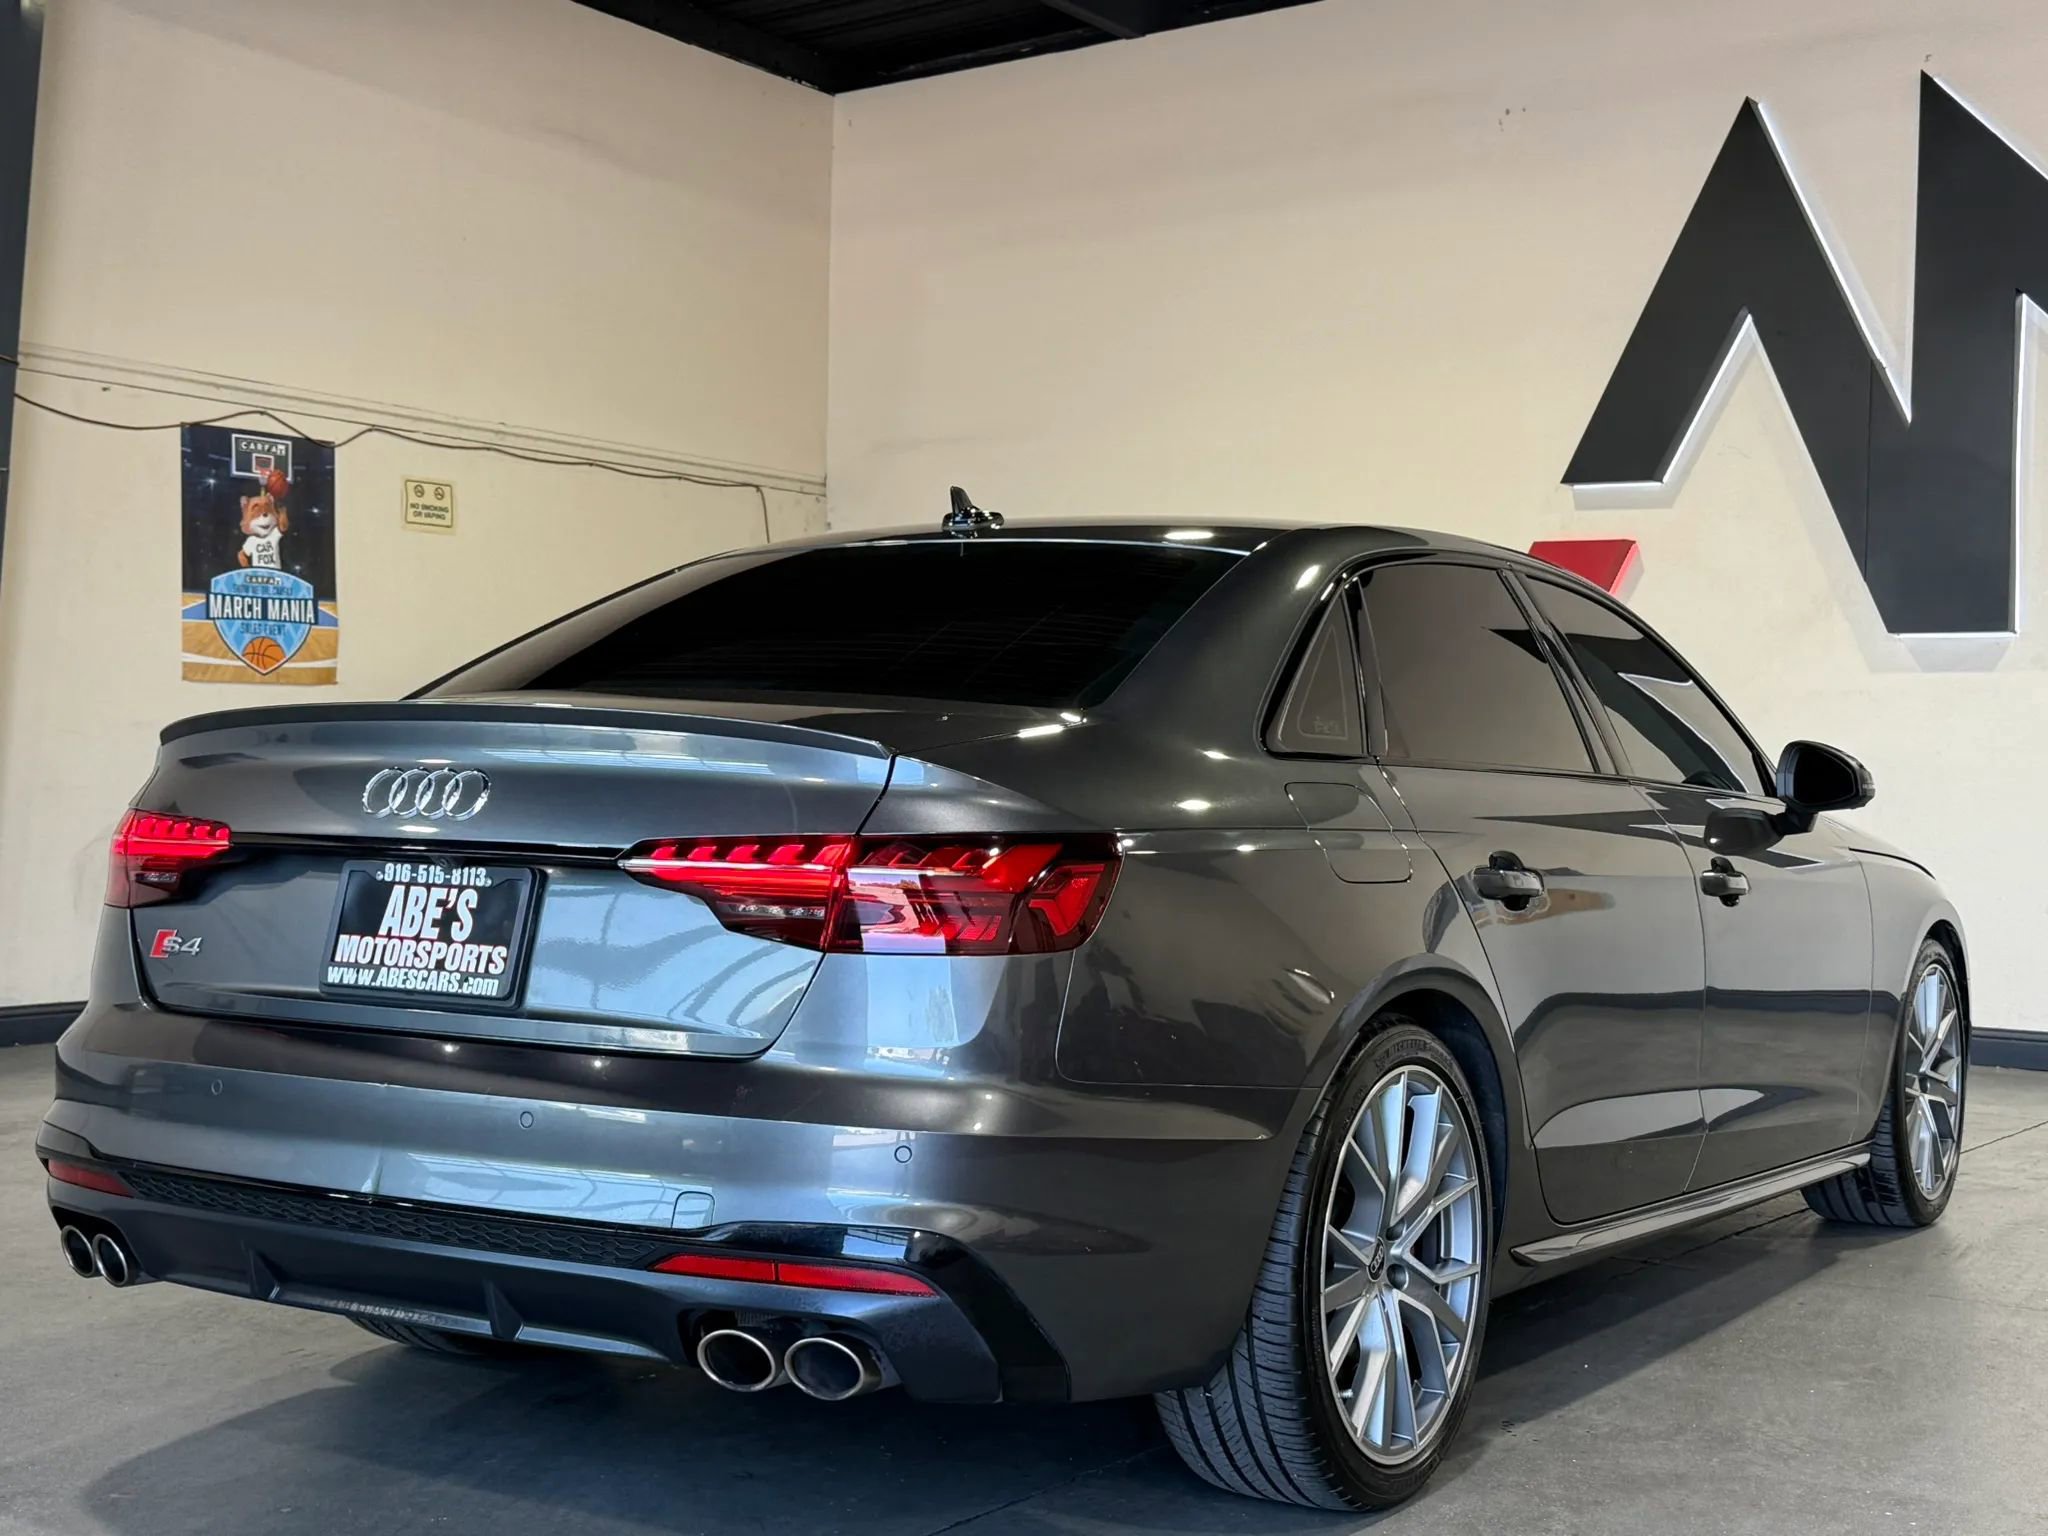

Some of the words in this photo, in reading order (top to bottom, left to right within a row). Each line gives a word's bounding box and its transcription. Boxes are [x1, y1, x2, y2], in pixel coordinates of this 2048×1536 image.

[421, 503, 449, 513] SMOKING
[256, 542, 274, 553] CAR
[258, 554, 276, 565] FOX
[209, 594, 262, 619] MARCH
[267, 599, 315, 623] MANIA
[383, 863, 487, 887] 916-515-8113
[378, 884, 478, 942] ABE'S
[163, 936, 203, 956] S4
[334, 934, 508, 975] MOTORSPORTS
